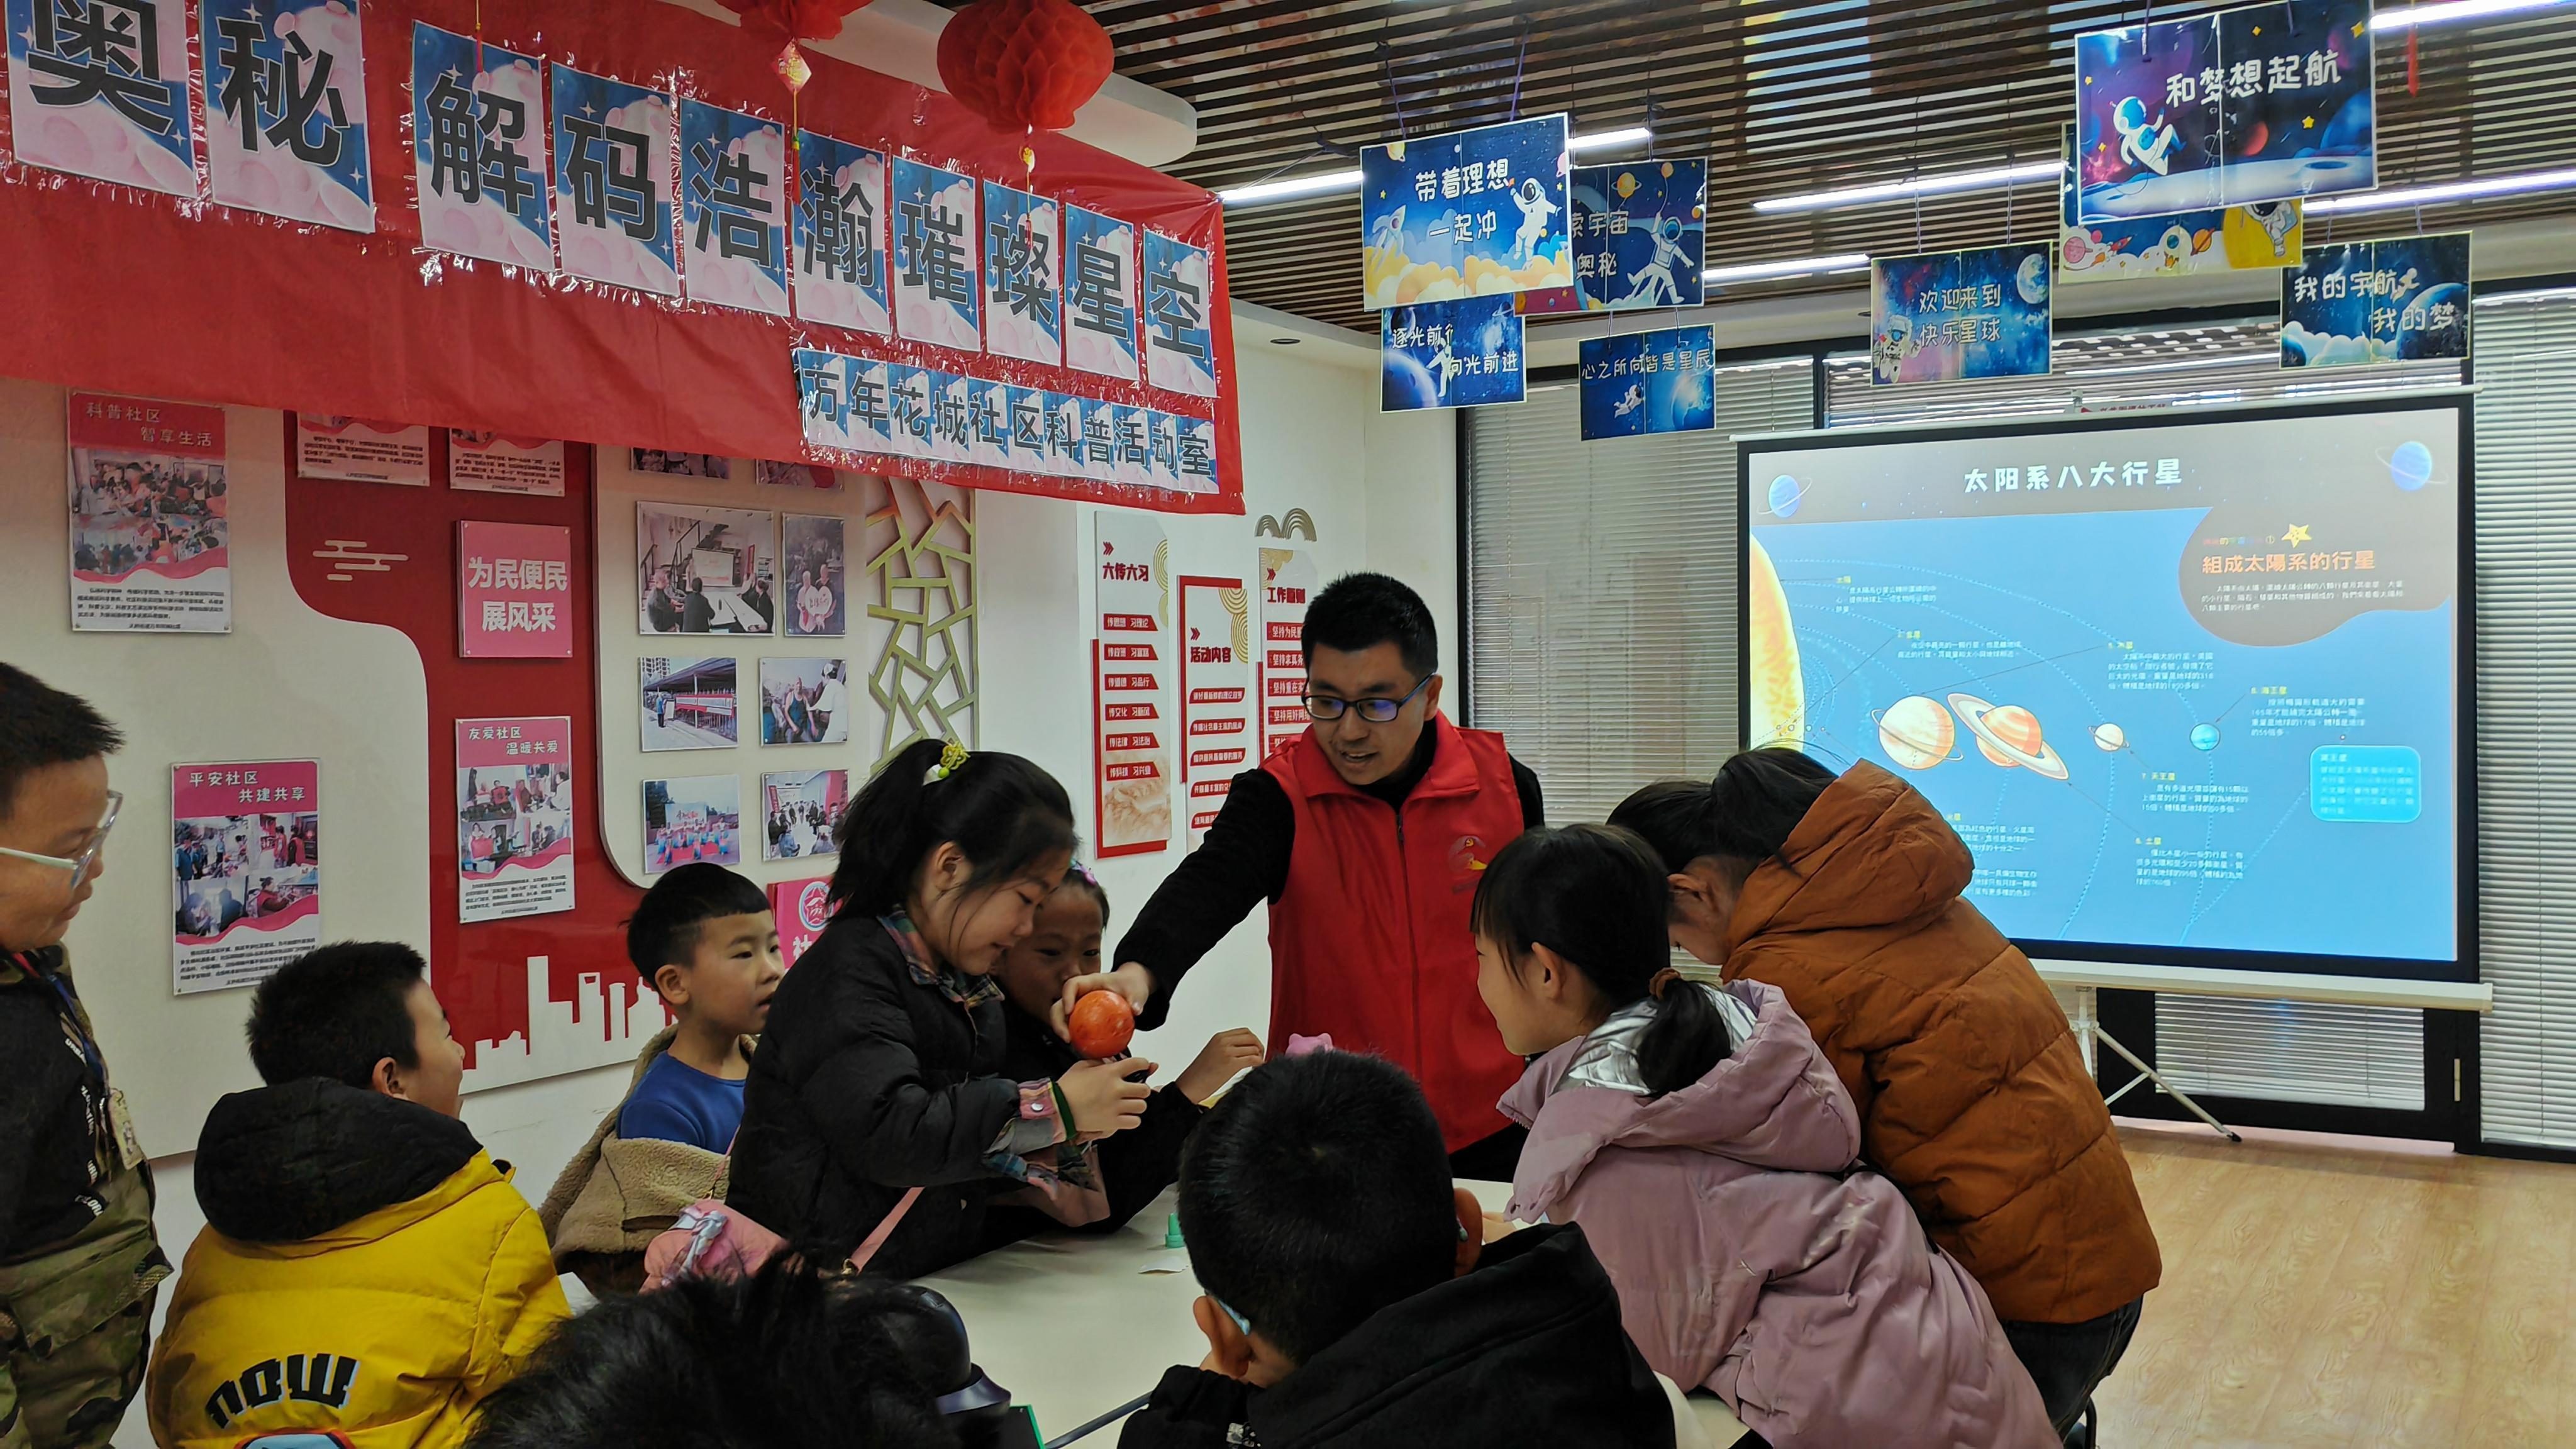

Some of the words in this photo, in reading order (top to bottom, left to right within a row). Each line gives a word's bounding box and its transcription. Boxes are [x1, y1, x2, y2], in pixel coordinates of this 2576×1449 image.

[2166, 50, 2341, 108] 和梦想起航
[27, 0, 350, 166] 奥秘
[426, 73, 1206, 358] 解码浩瀚璀璨星空
[1416, 158, 1509, 202] 带着理想
[1430, 210, 1497, 245] 一起冲
[1577, 252, 1617, 280] 奥秘
[1919, 284, 2001, 313] 欢迎来到
[2294, 269, 2397, 303] 我的宇航
[2373, 301, 2456, 333] 我的梦
[1919, 318, 2001, 347] 快乐星球
[1450, 350, 1519, 376] 向光前进
[1582, 348, 1713, 380] 心之所向皆是星辰
[86, 402, 161, 423] 科普社区
[802, 367, 1213, 477] 万年花城社区科普活动室
[141, 427, 213, 447] 智享生活
[1963, 457, 2183, 494] 太阳系八大行星
[468, 557, 568, 591] 为民便民
[1102, 562, 1149, 582] 六传六习
[2201, 550, 2376, 575] 組成太陽系的行星
[482, 601, 556, 632] 展风采
[1190, 647, 1231, 663] 活动内容
[469, 726, 522, 740] 友爱社区
[506, 740, 558, 755] 温暖关爱
[190, 770, 258, 787] 平安社区
[238, 787, 306, 803] 共建共享
